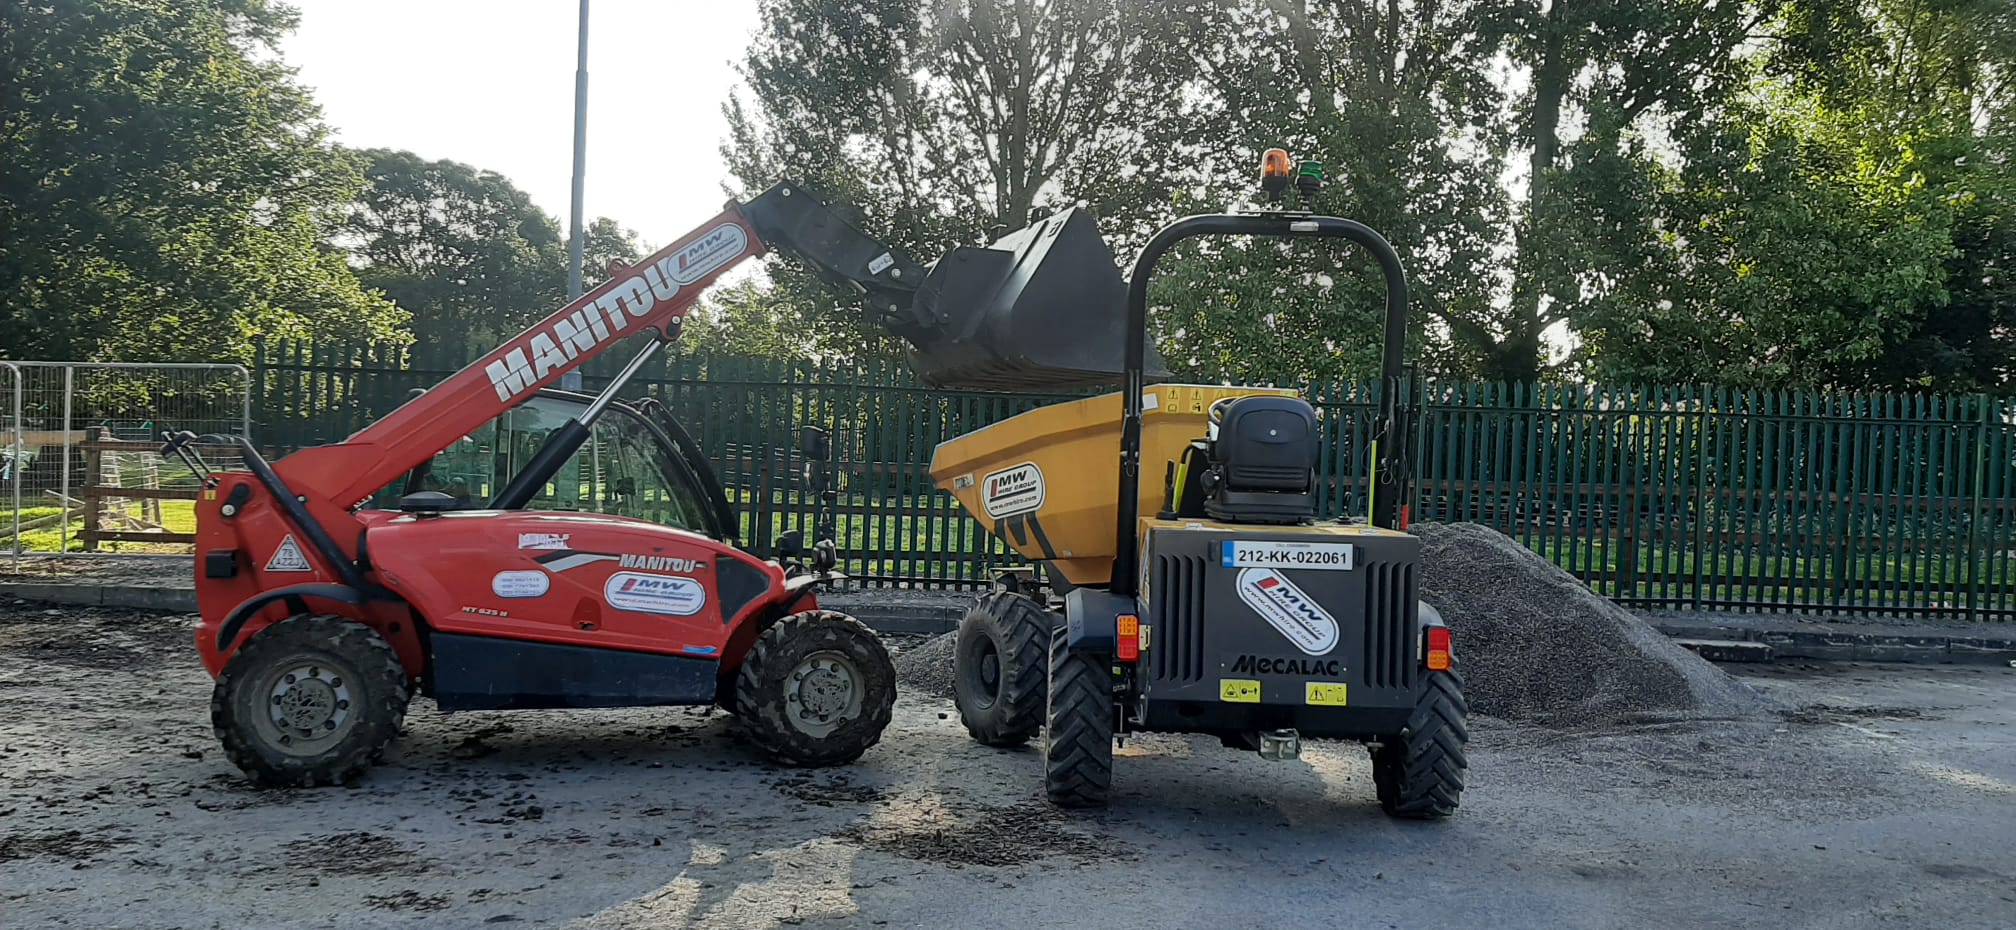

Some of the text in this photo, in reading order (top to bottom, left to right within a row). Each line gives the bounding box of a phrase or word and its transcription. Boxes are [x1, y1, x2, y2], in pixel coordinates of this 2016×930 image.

[485, 257, 680, 402] MANITOU
[998, 470, 1027, 487] MW
[1014, 480, 1037, 490] GROUP
[619, 554, 696, 573] MANITOU
[1238, 549, 1347, 564] 212-KK-022061
[638, 579, 687, 590] MW
[1276, 586, 1324, 621] MW
[1244, 586, 1313, 645] www.mwhire.com
[1268, 590, 1326, 638] HIRE GROUP
